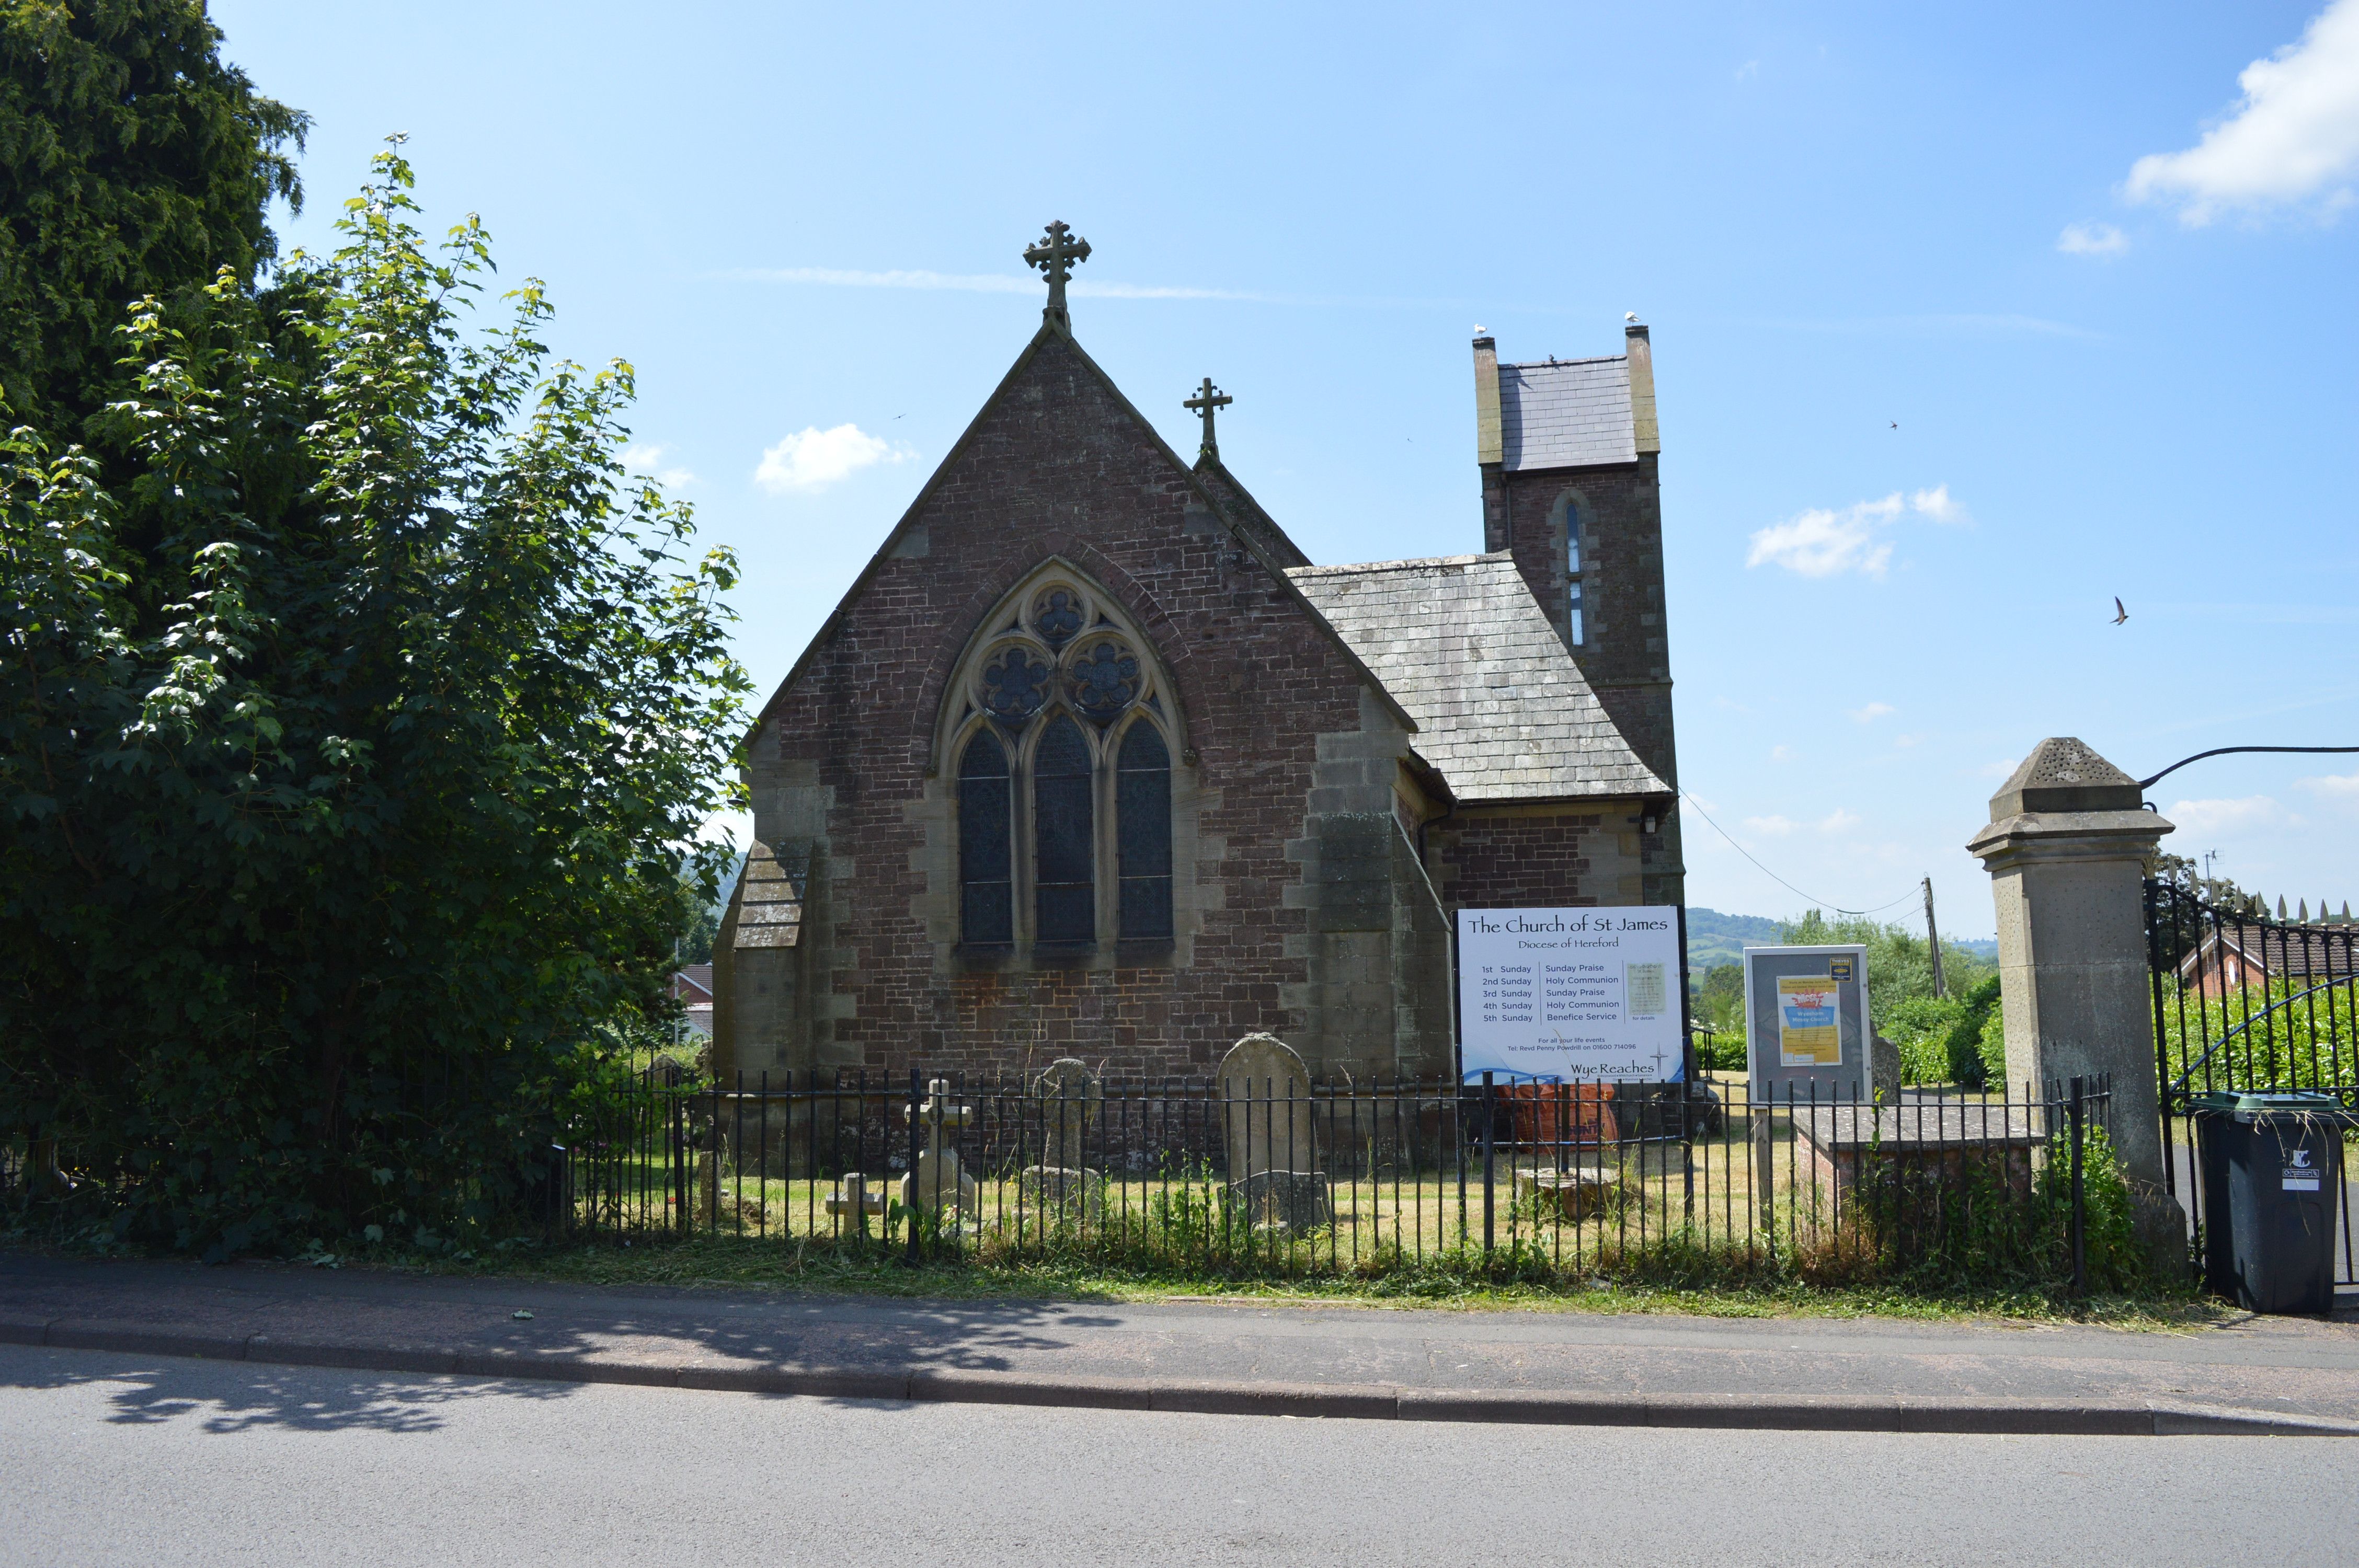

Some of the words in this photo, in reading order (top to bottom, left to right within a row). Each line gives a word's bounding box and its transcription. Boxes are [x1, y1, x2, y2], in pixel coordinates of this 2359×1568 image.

[1468, 916, 1501, 933] The
[1506, 915, 1564, 932] Church
[1570, 914, 1589, 931] of
[1594, 918, 1612, 931] St
[1617, 918, 1668, 931] James
[1518, 940, 1558, 949] Diocese
[1561, 937, 1572, 948] of
[1575, 937, 1619, 948] Hereford
[1501, 977, 1532, 986] Sunday
[1546, 977, 1565, 985] Holy
[1502, 989, 1532, 998] Sunday
[1546, 989, 1577, 997] Sunday
[1502, 1002, 1532, 1010] Sunday
[1547, 1001, 1565, 1010] Holy
[1502, 1014, 1533, 1022] Sunday
[1571, 1064, 1597, 1079] Wye
[1600, 1059, 1654, 1074] Reaches
